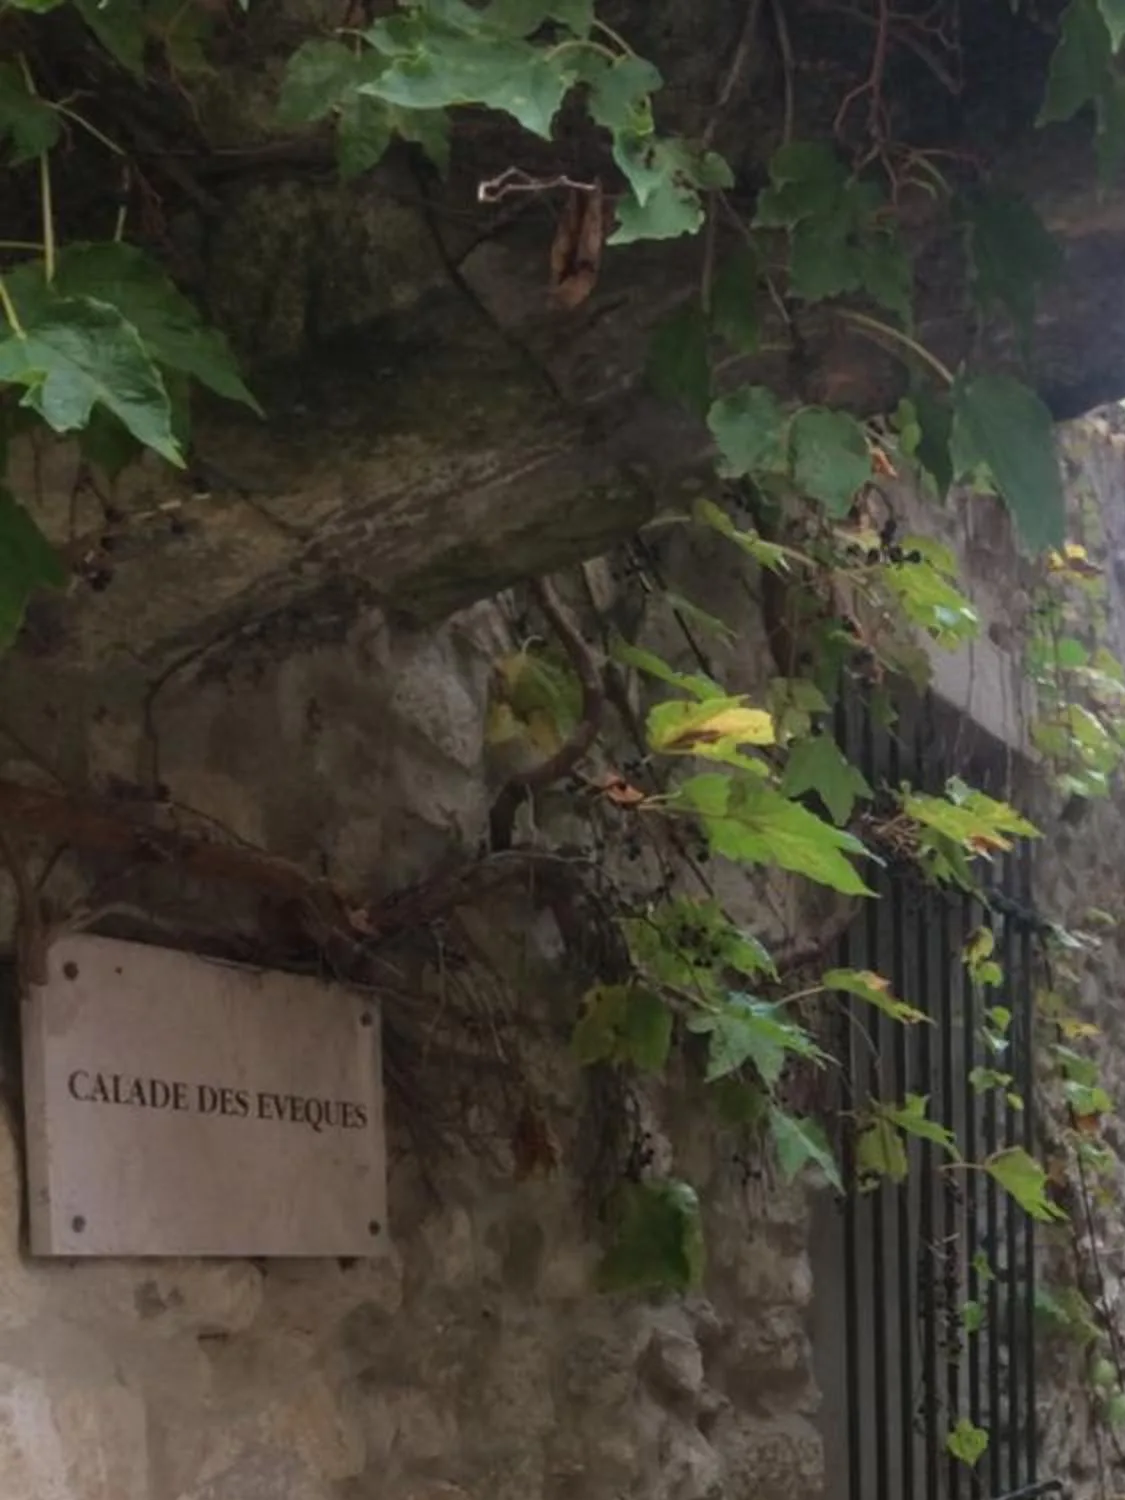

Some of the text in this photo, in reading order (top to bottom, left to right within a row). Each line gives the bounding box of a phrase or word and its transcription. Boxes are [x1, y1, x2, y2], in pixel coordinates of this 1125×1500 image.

[68, 1070, 367, 1132] CALADE DES EVEQUES
